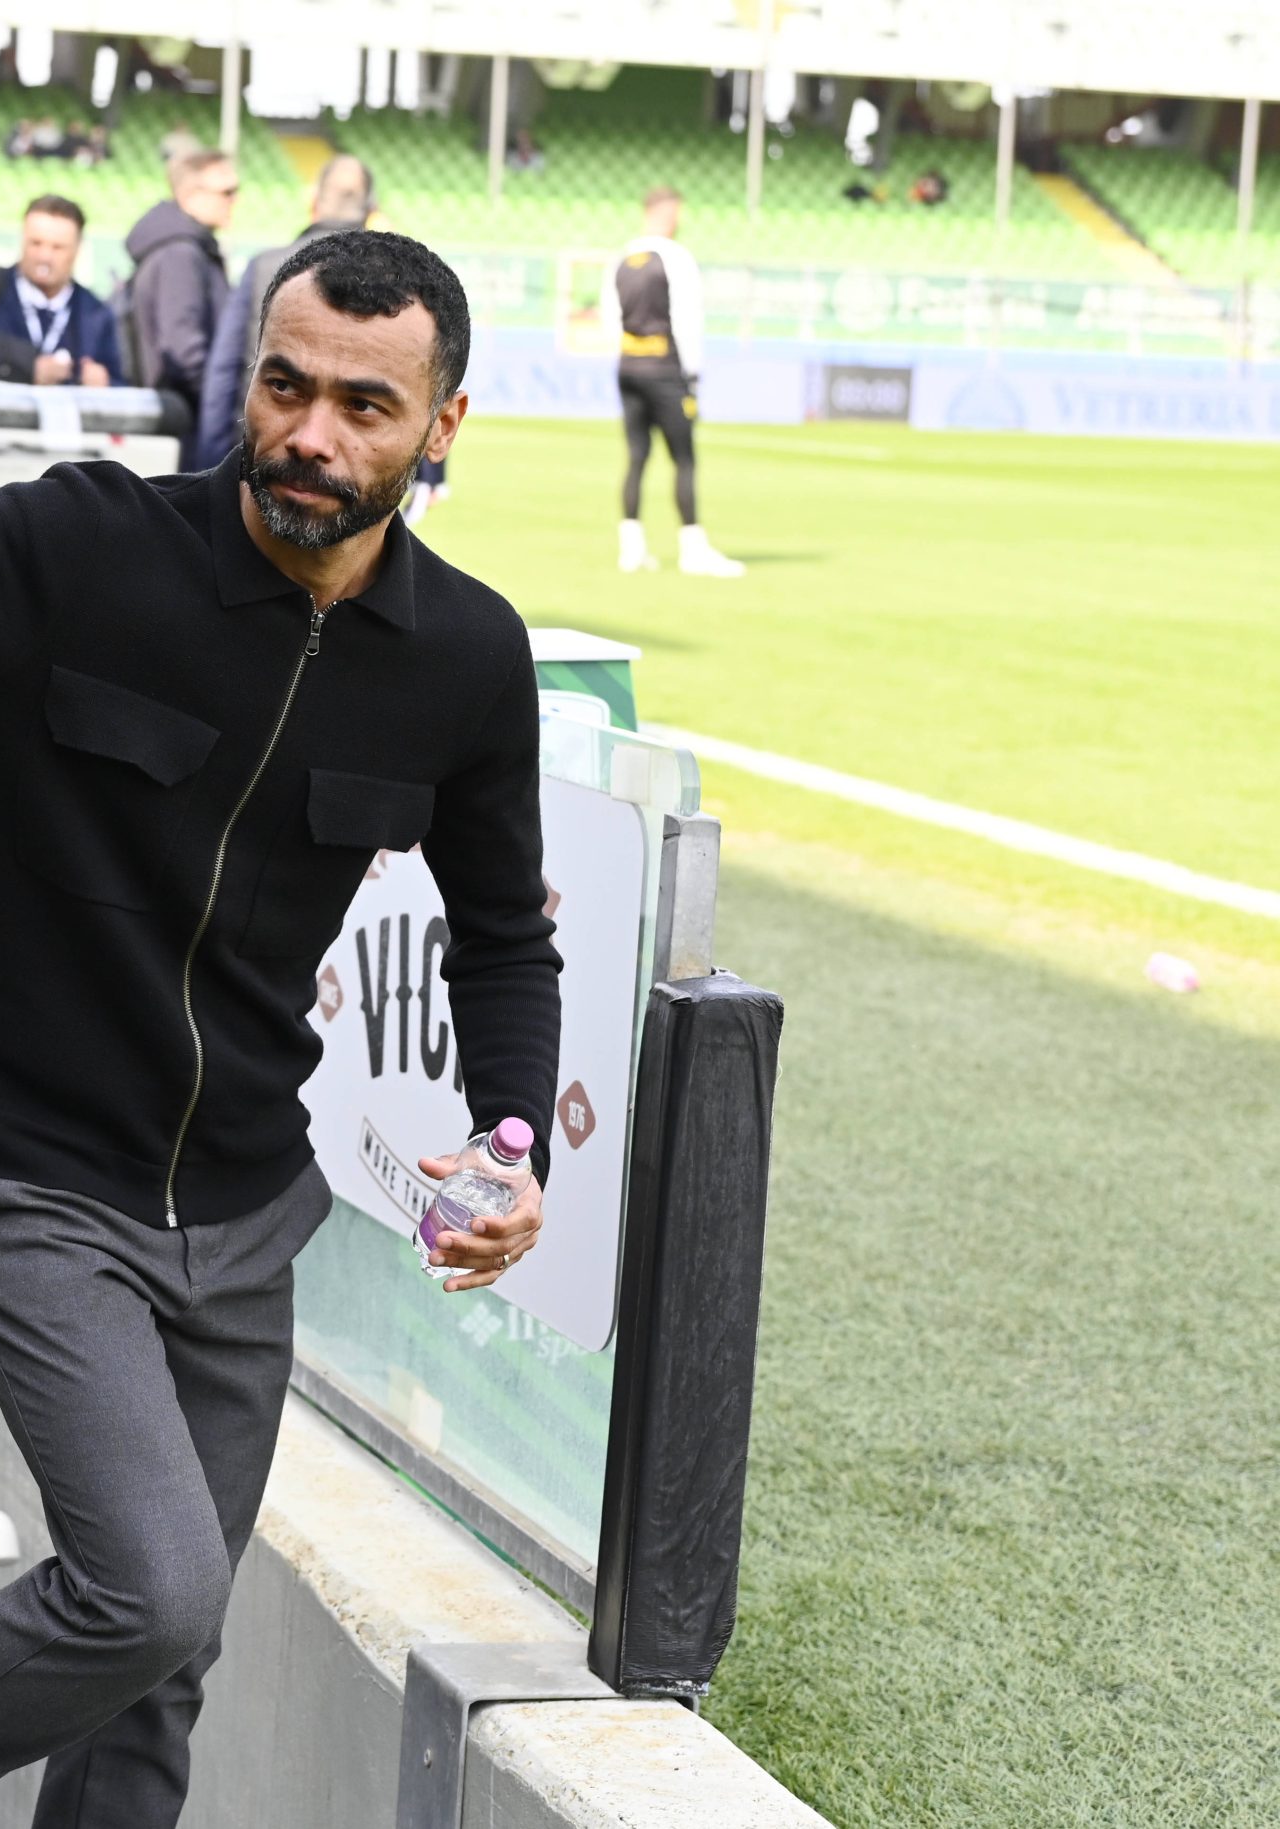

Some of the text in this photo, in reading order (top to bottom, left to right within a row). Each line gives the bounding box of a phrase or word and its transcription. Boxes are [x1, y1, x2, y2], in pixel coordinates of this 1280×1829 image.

[355, 912, 464, 1094] VIC
[568, 1100, 586, 1132] 1976
[364, 1128, 428, 1217] MORE THA
